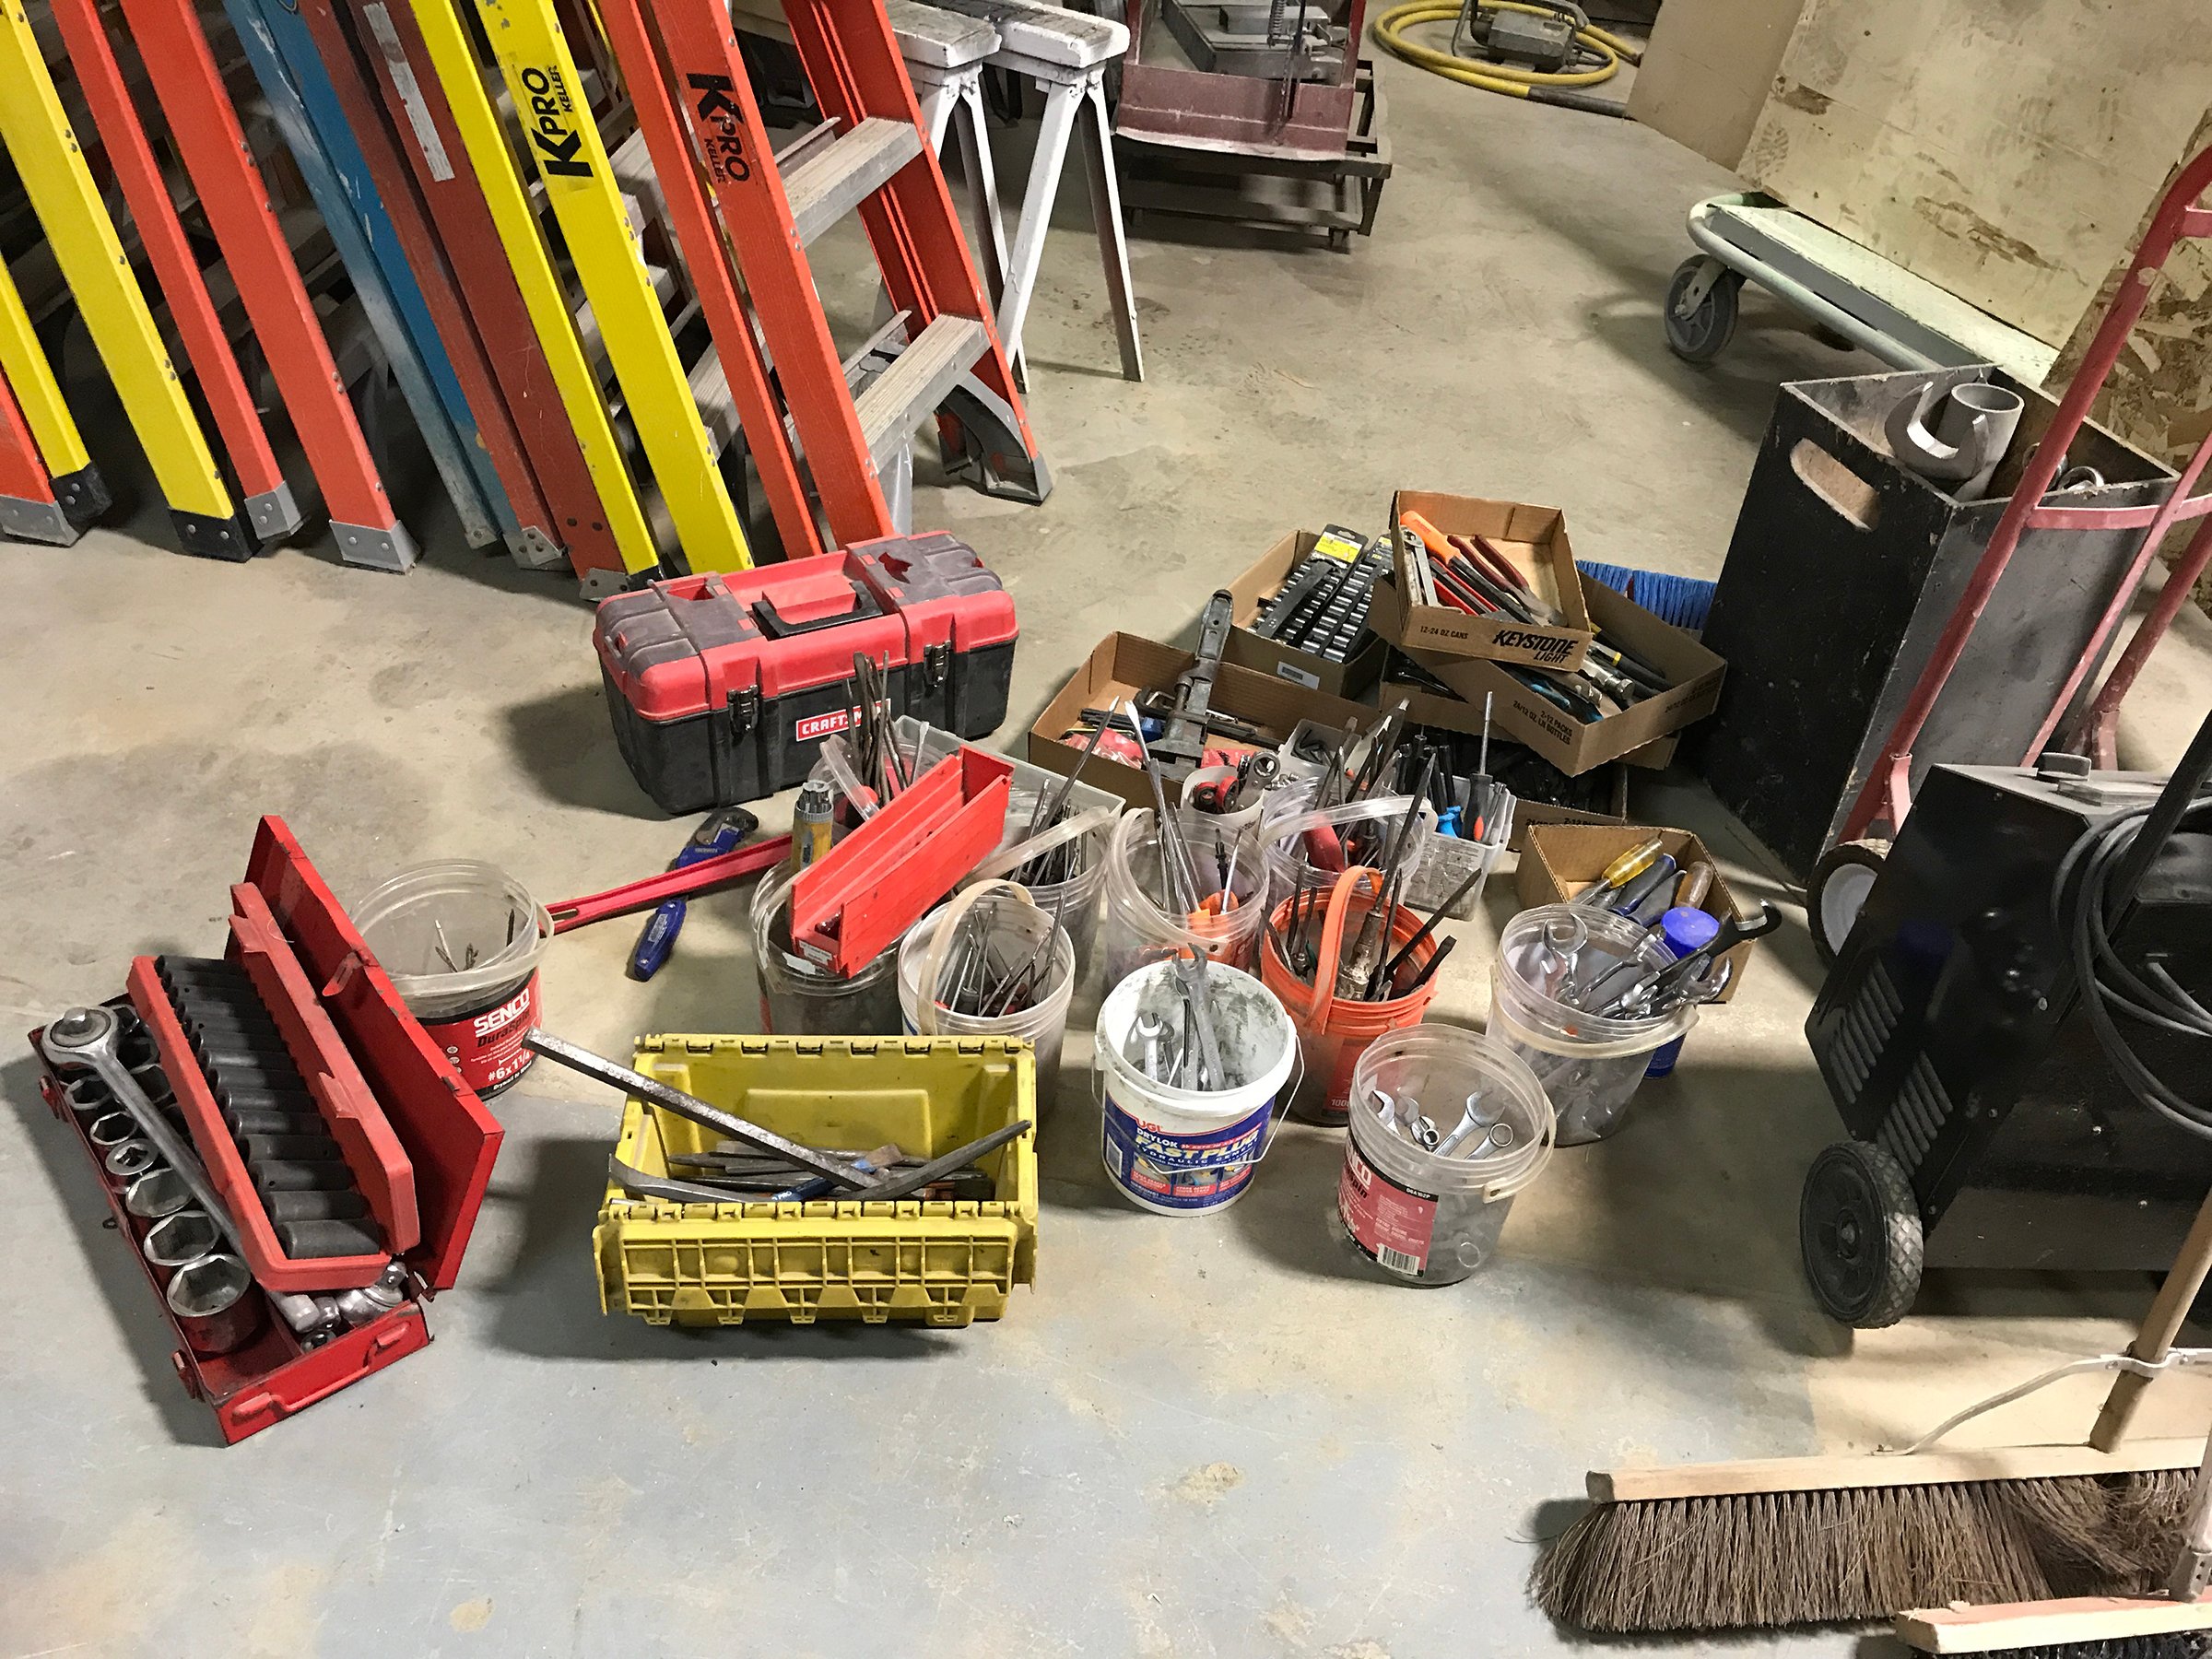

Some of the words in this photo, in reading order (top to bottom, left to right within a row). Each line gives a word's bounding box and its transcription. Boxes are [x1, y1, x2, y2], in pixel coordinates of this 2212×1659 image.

[547, 65, 573, 112] KELLER
[704, 138, 726, 183] KELLER
[1420, 626, 1439, 635] 12-24
[1451, 631, 1469, 640] CANS
[1492, 629, 1579, 655] KEYSTONE
[1534, 652, 1570, 664] LIGHT
[1546, 724, 1571, 746] BOTTLES
[1554, 719, 1572, 737] PACKS
[473, 987, 530, 1034] SENCO
[1137, 1127, 1178, 1148] DRYLOK
